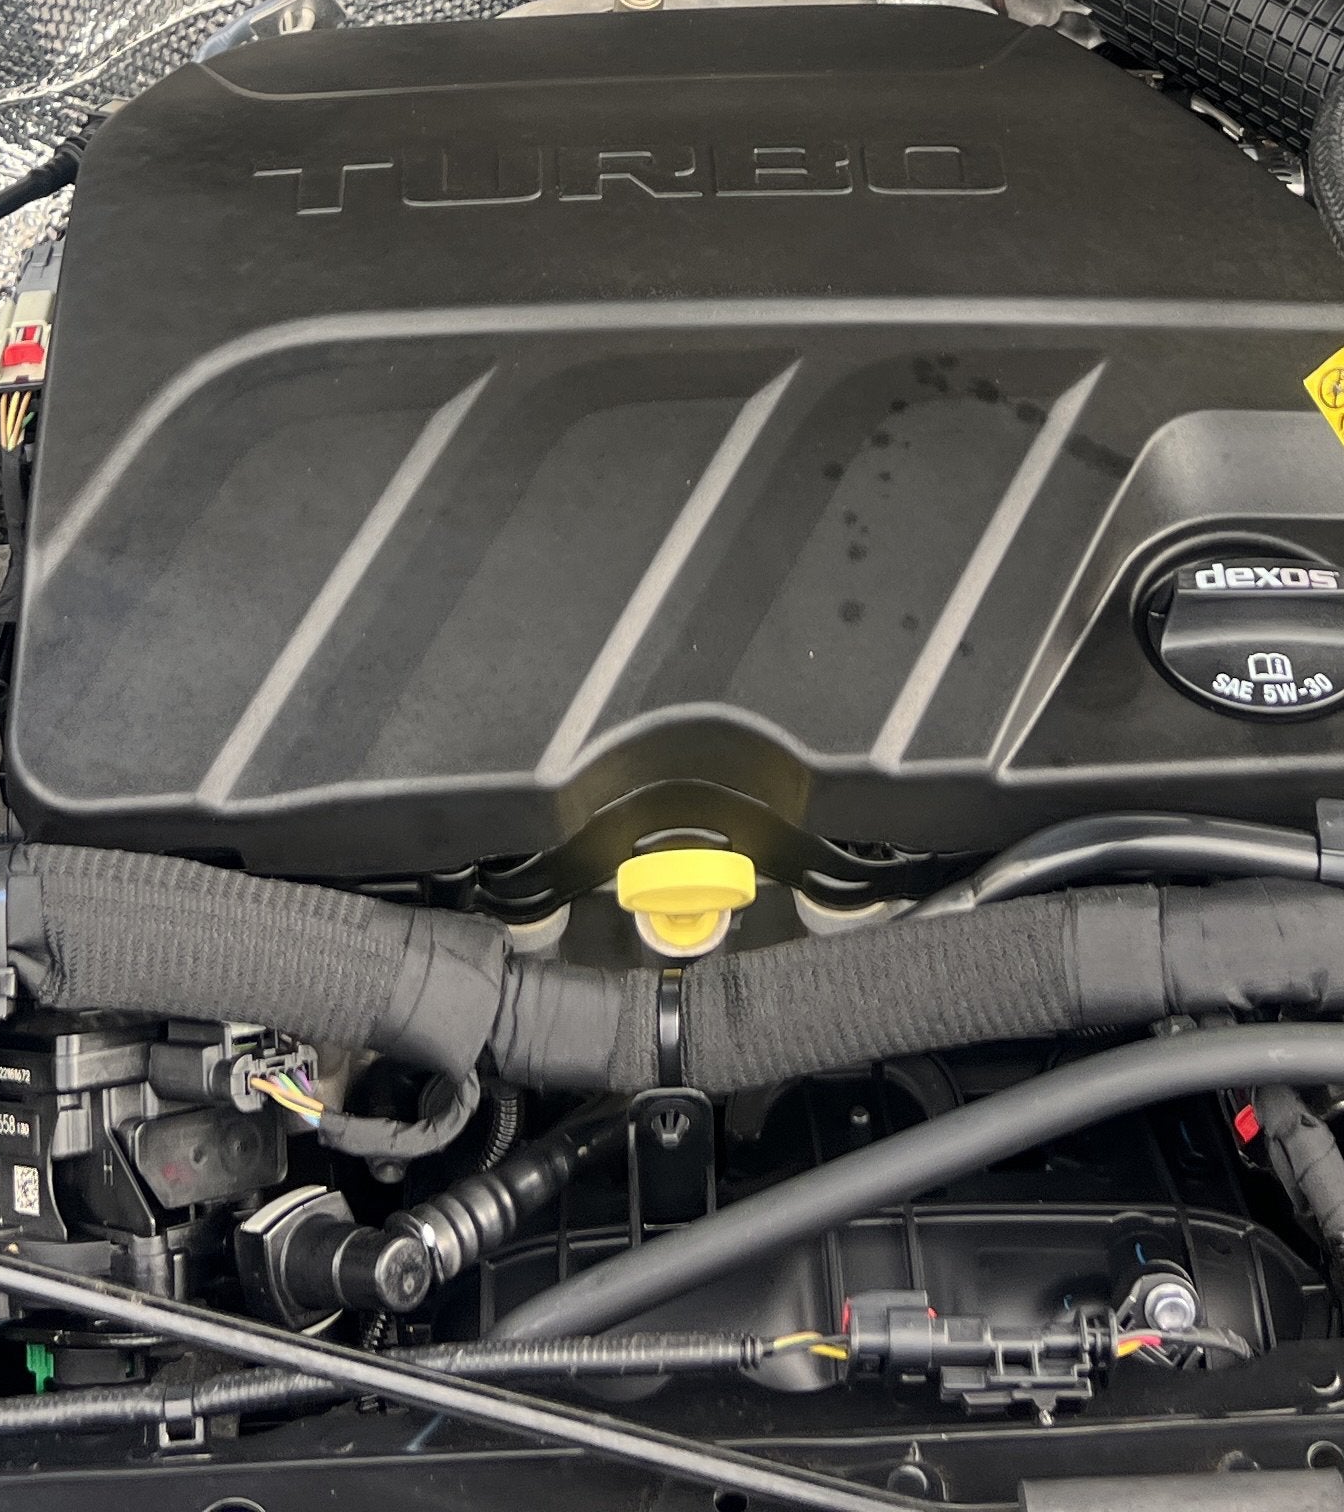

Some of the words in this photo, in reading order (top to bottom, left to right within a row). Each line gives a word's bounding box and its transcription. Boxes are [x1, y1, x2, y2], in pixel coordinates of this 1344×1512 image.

[253, 142, 1010, 215] TURBO
[1194, 562, 1338, 590] dexos
[1212, 672, 1256, 702] SAE
[1262, 671, 1334, 705] 5W-30
